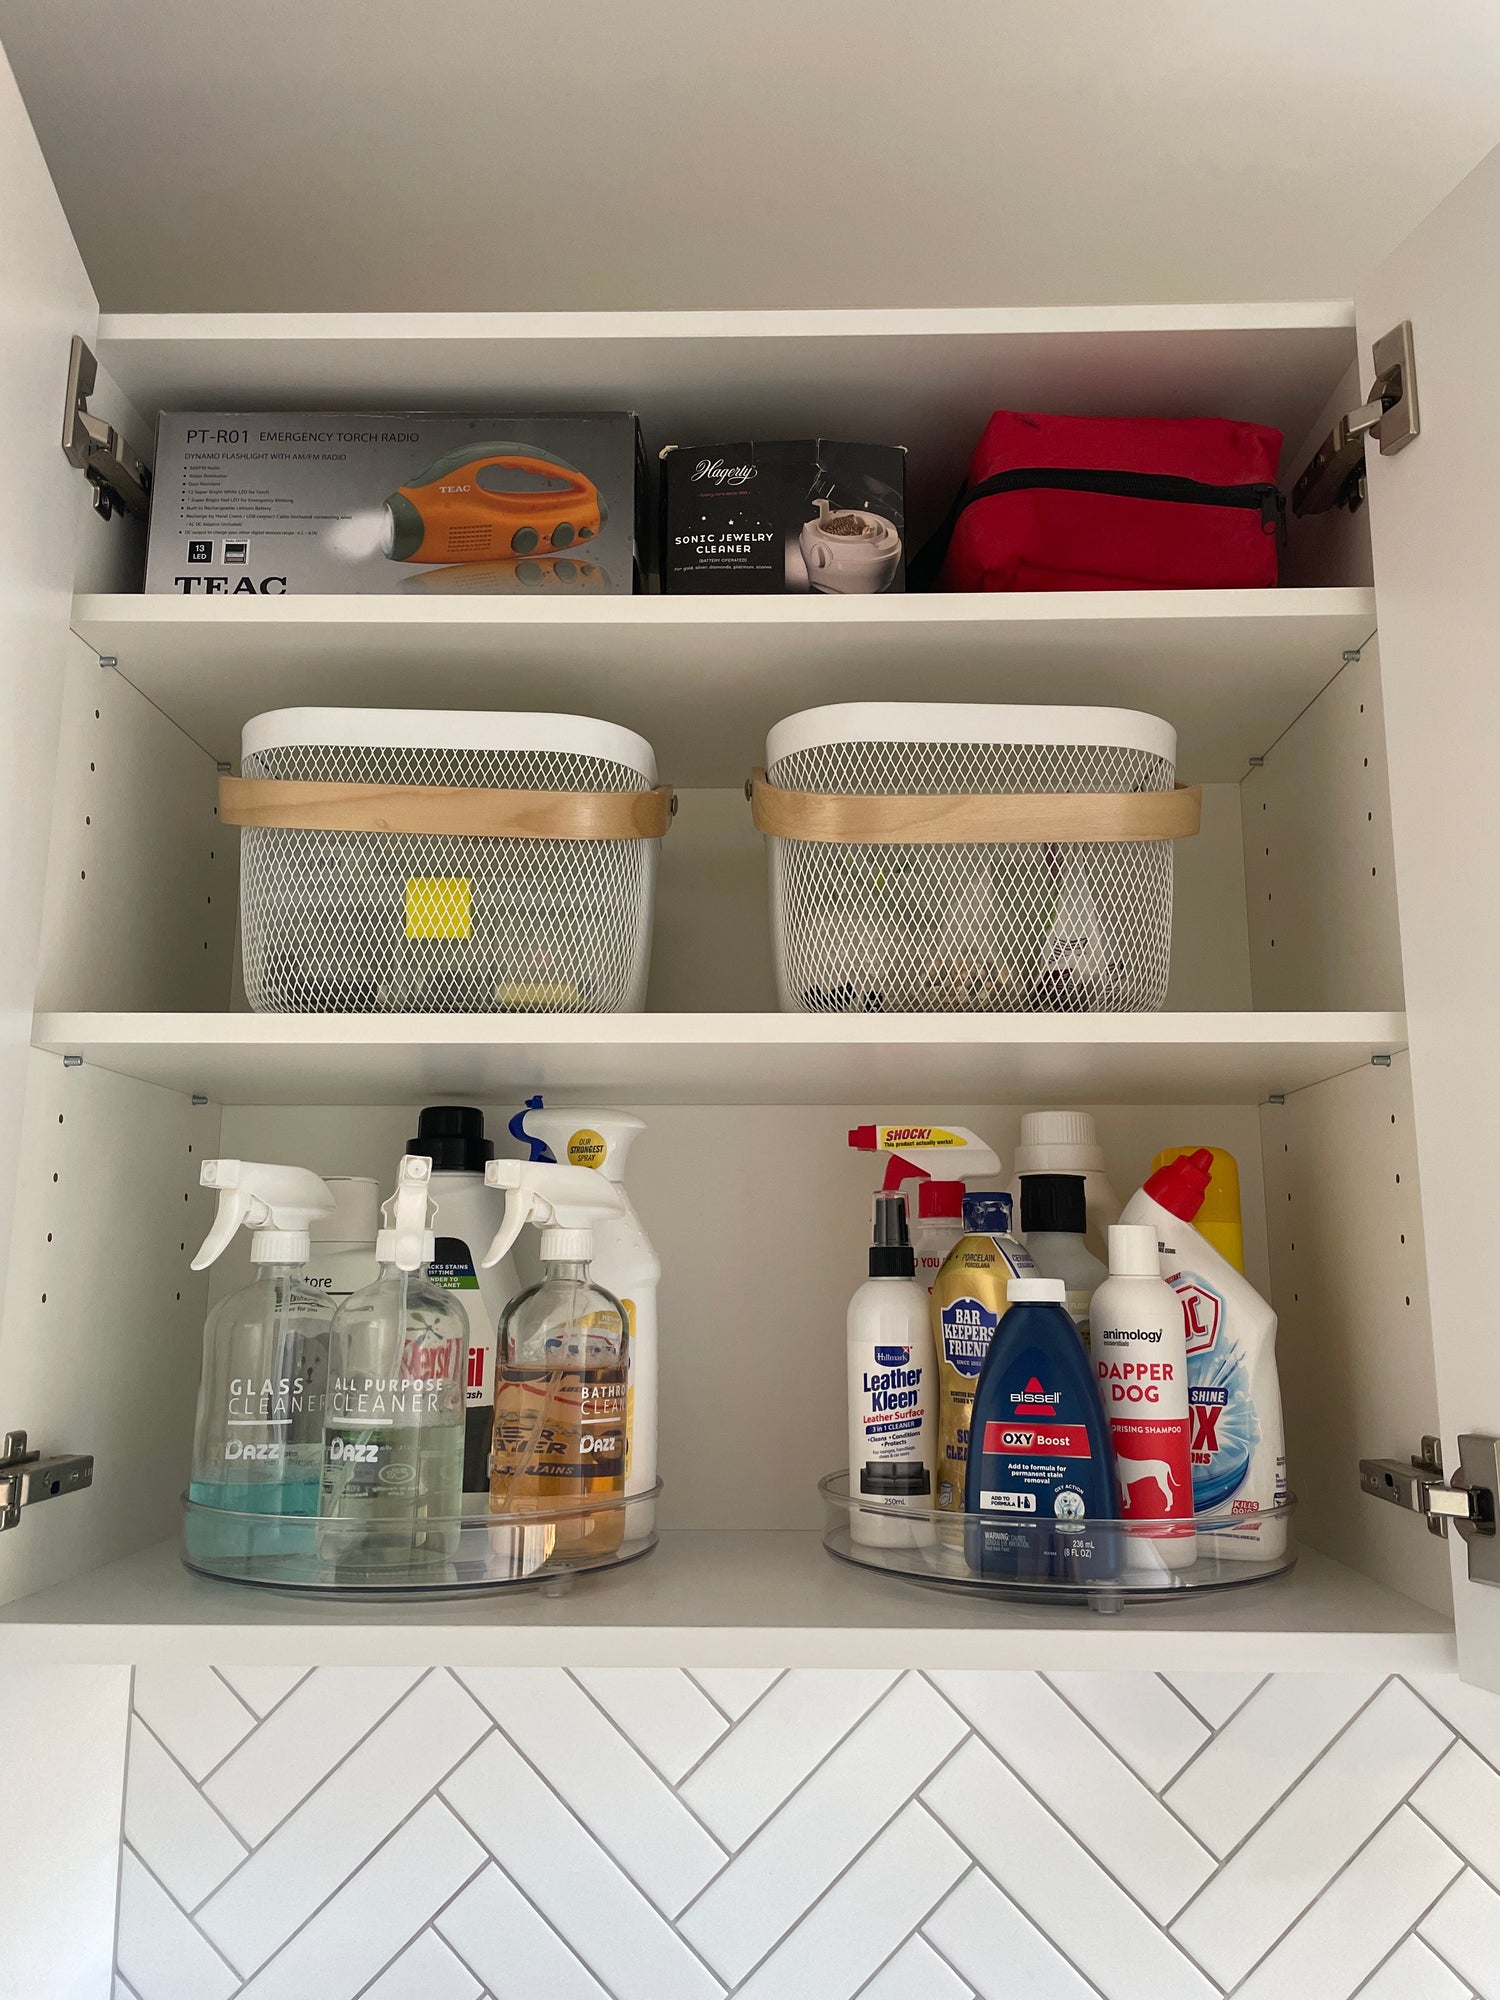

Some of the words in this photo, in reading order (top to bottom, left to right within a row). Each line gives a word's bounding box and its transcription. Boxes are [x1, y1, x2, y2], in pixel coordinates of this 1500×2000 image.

[186, 429, 249, 444] PT-R01
[259, 431, 334, 442] EMERGENCY
[336, 432, 379, 442] TORCH
[381, 432, 420, 442] RADIO
[292, 453, 320, 461] AM/FM
[690, 458, 758, 486] Hagerty
[439, 485, 471, 494] TEAC
[674, 534, 716, 545] SONIC
[718, 533, 774, 542] JEWELRY
[195, 544, 205, 552] 13
[696, 544, 752, 554] CLEANER
[174, 576, 287, 595] TEAC
[885, 1128, 932, 1142] SHOCK!
[578, 1138, 592, 1146] OUR
[570, 1145, 604, 1154] STRONGEST
[577, 1154, 596, 1162] SPRAY
[921, 1257, 940, 1268] YOU
[961, 1253, 996, 1263] PORCELAIN
[304, 1275, 332, 1288] tore
[955, 1308, 981, 1325] BAR
[1181, 1296, 1207, 1338] IC
[943, 1323, 996, 1342] KEEPERS
[1103, 1329, 1162, 1343] animology
[876, 1352, 908, 1361] Hillmark
[467, 1347, 485, 1387] il
[1098, 1361, 1174, 1381] DAPPER
[230, 1377, 304, 1396] GLASS
[334, 1377, 357, 1391] ALL
[364, 1378, 444, 1392] PURPOSE
[863, 1368, 922, 1393] Leather
[580, 1383, 626, 1399] BATHRO
[1111, 1384, 1159, 1403] DOG
[1191, 1390, 1225, 1403] SHINE
[333, 1392, 438, 1413] CLEANER
[872, 1389, 918, 1412] Kleen
[580, 1399, 626, 1416] CLEAN
[863, 1413, 894, 1423] Leather
[894, 1408, 925, 1420] Surface
[888, 1420, 915, 1431] CLEANER
[1112, 1424, 1143, 1434] ORISING
[1145, 1426, 1182, 1434] SHAMPOO
[891, 1431, 920, 1440] Conditions
[1003, 1433, 1033, 1445] OXY
[1037, 1436, 1070, 1446] Boost
[945, 1444, 968, 1462] CLEA
[532, 1465, 575, 1475] TAINS
[1054, 1485, 1065, 1493] OXY
[1065, 1484, 1084, 1494] ACTION
[1233, 1501, 1258, 1509] KILLS
[984, 1532, 1009, 1540] WARNING:
[1072, 1540, 1084, 1548] 236
[1085, 1541, 1095, 1549] mL
[1071, 1549, 1079, 1557] FL
[1080, 1549, 1092, 1558] OZ)
